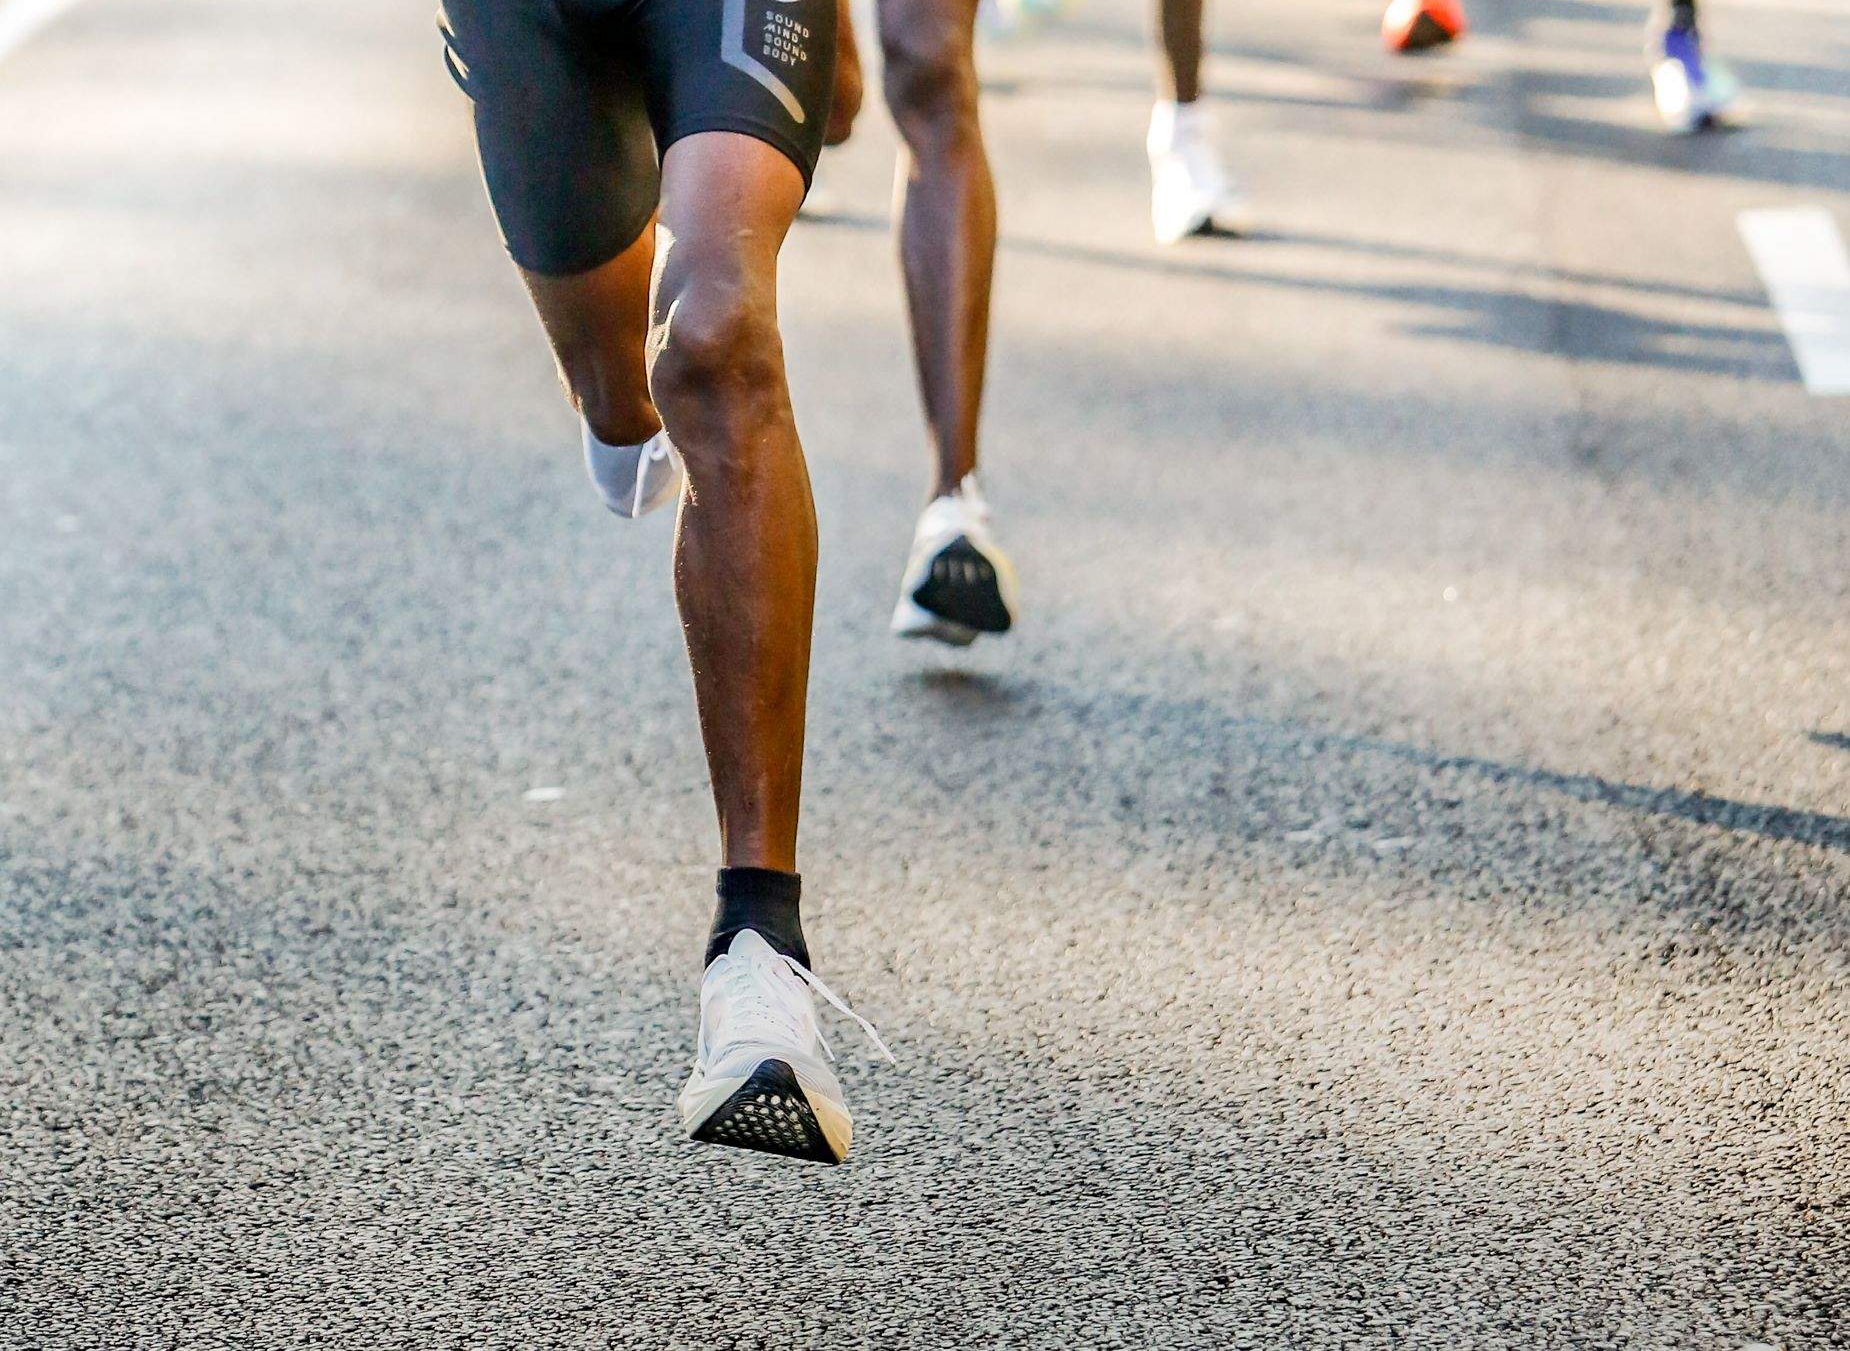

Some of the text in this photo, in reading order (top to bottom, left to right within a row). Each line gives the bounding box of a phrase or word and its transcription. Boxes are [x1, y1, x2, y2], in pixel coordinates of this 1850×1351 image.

[765, 10, 809, 39] SOUND
[762, 44, 797, 66] BODY
[764, 33, 807, 61] SOUND
